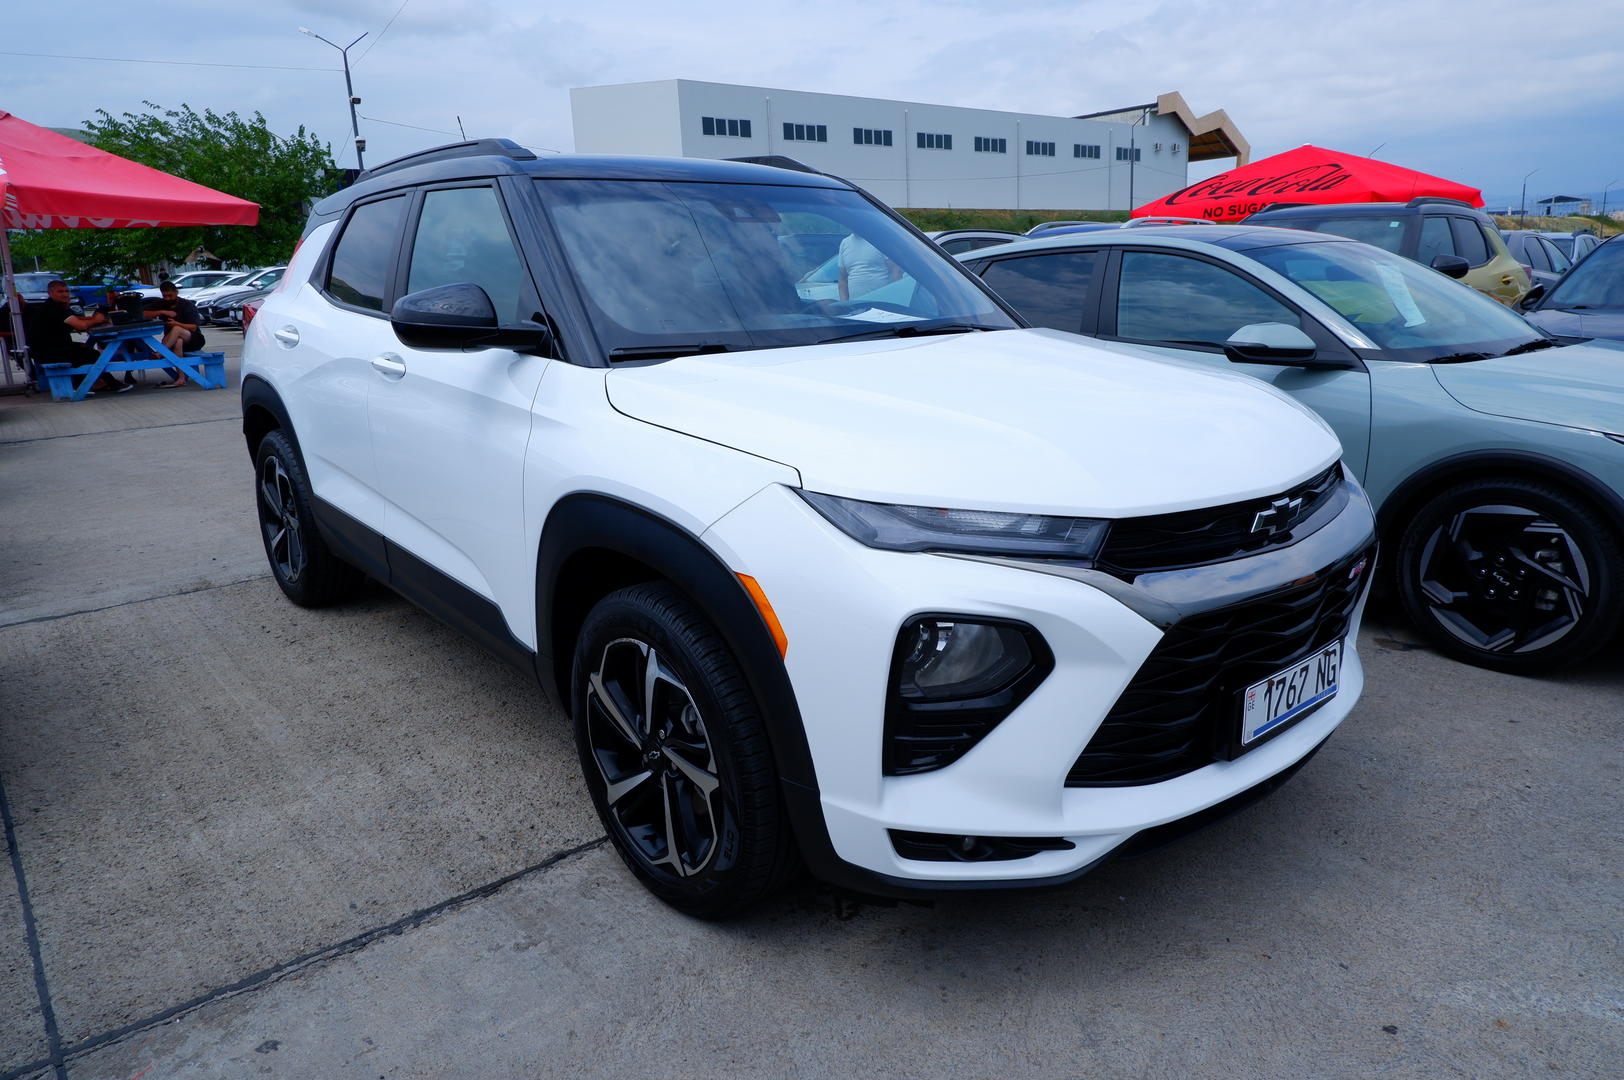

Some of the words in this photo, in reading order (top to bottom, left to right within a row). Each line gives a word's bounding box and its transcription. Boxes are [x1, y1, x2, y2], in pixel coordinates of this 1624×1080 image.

[1202, 206, 1224, 219] NO
[1227, 202, 1277, 216] SUGA
[1264, 665, 1310, 721] 1767
[1315, 649, 1337, 693] NG
[1247, 700, 1255, 711] GE
